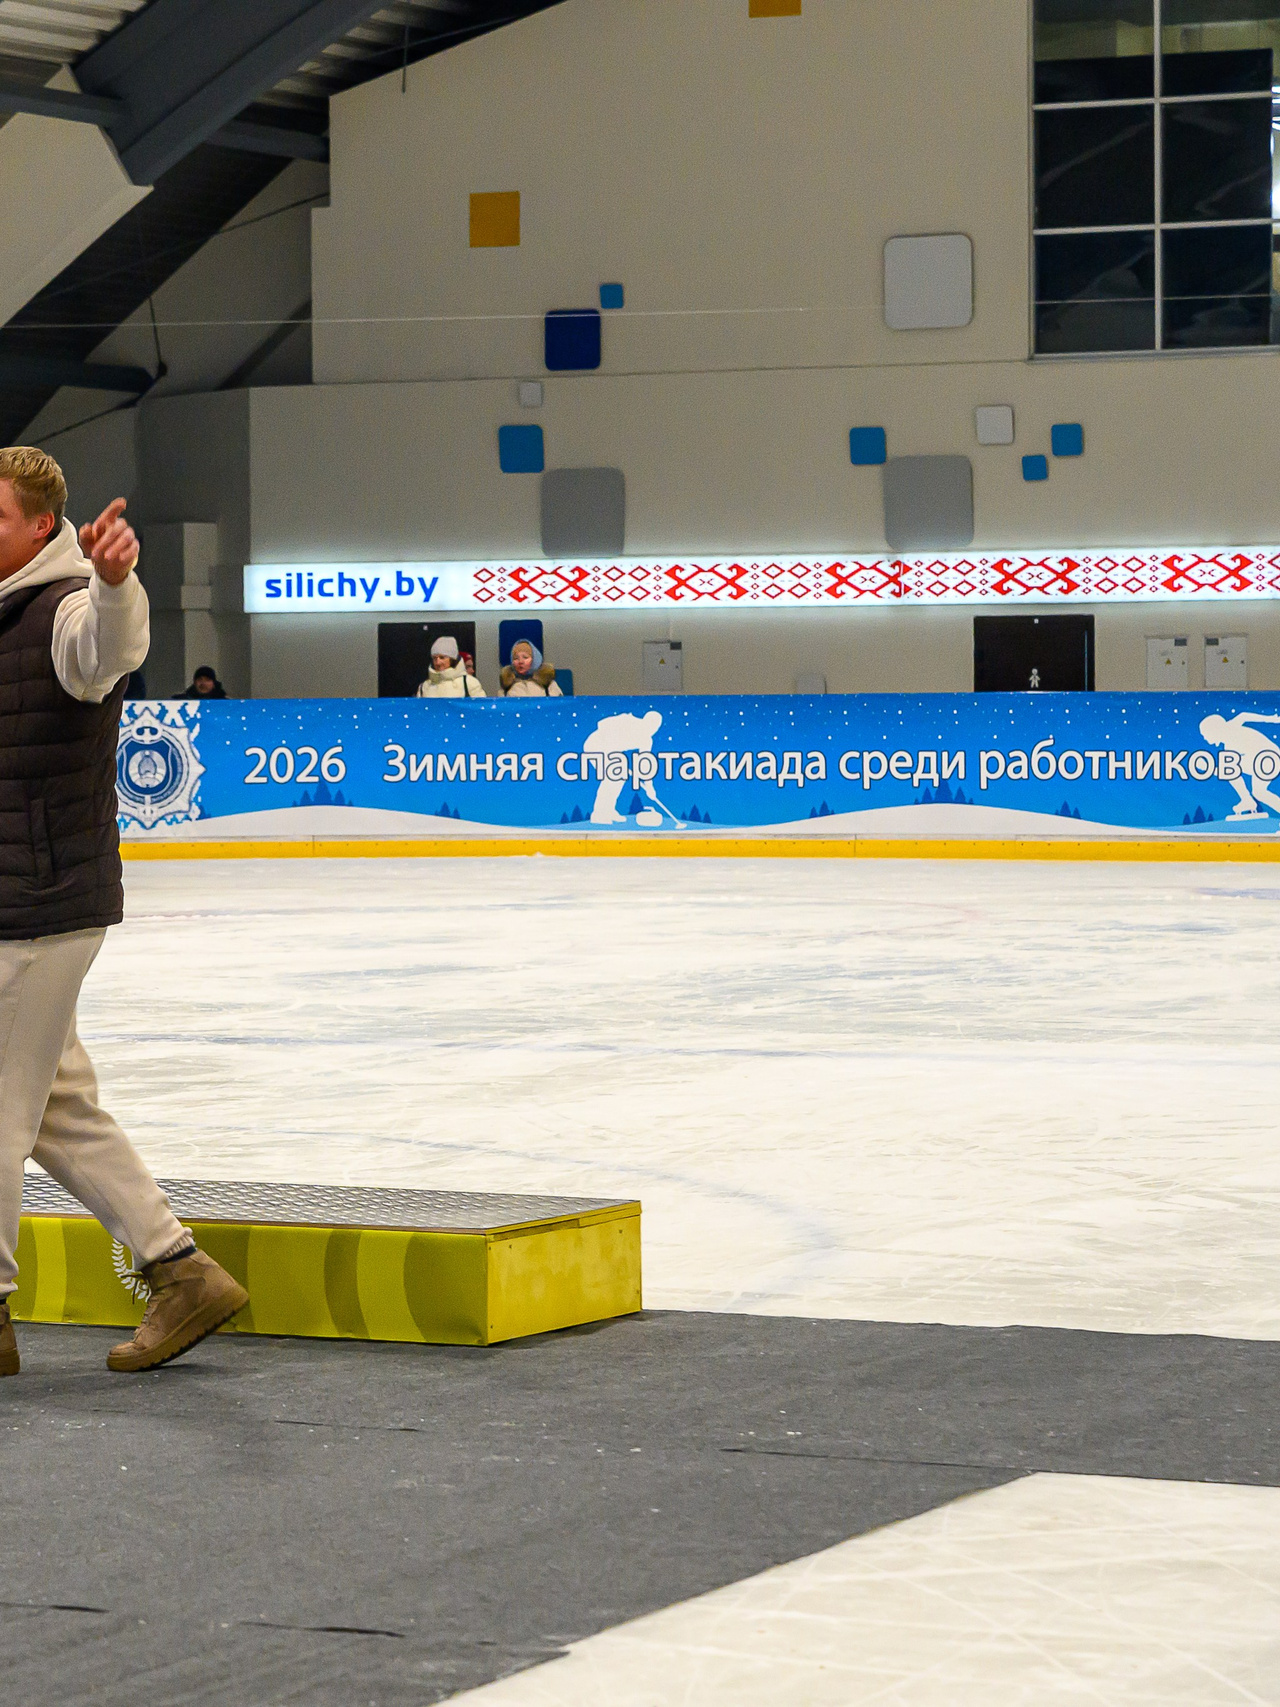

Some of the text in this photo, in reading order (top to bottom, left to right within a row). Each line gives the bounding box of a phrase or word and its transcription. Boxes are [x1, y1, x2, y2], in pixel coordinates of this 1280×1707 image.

[265, 570, 439, 603] silichy.by
[243, 745, 347, 784] 2026
[382, 743, 545, 783] Зимняя
[556, 750, 827, 790] спартакиада
[838, 749, 966, 790] среди
[979, 739, 1243, 790] работников
